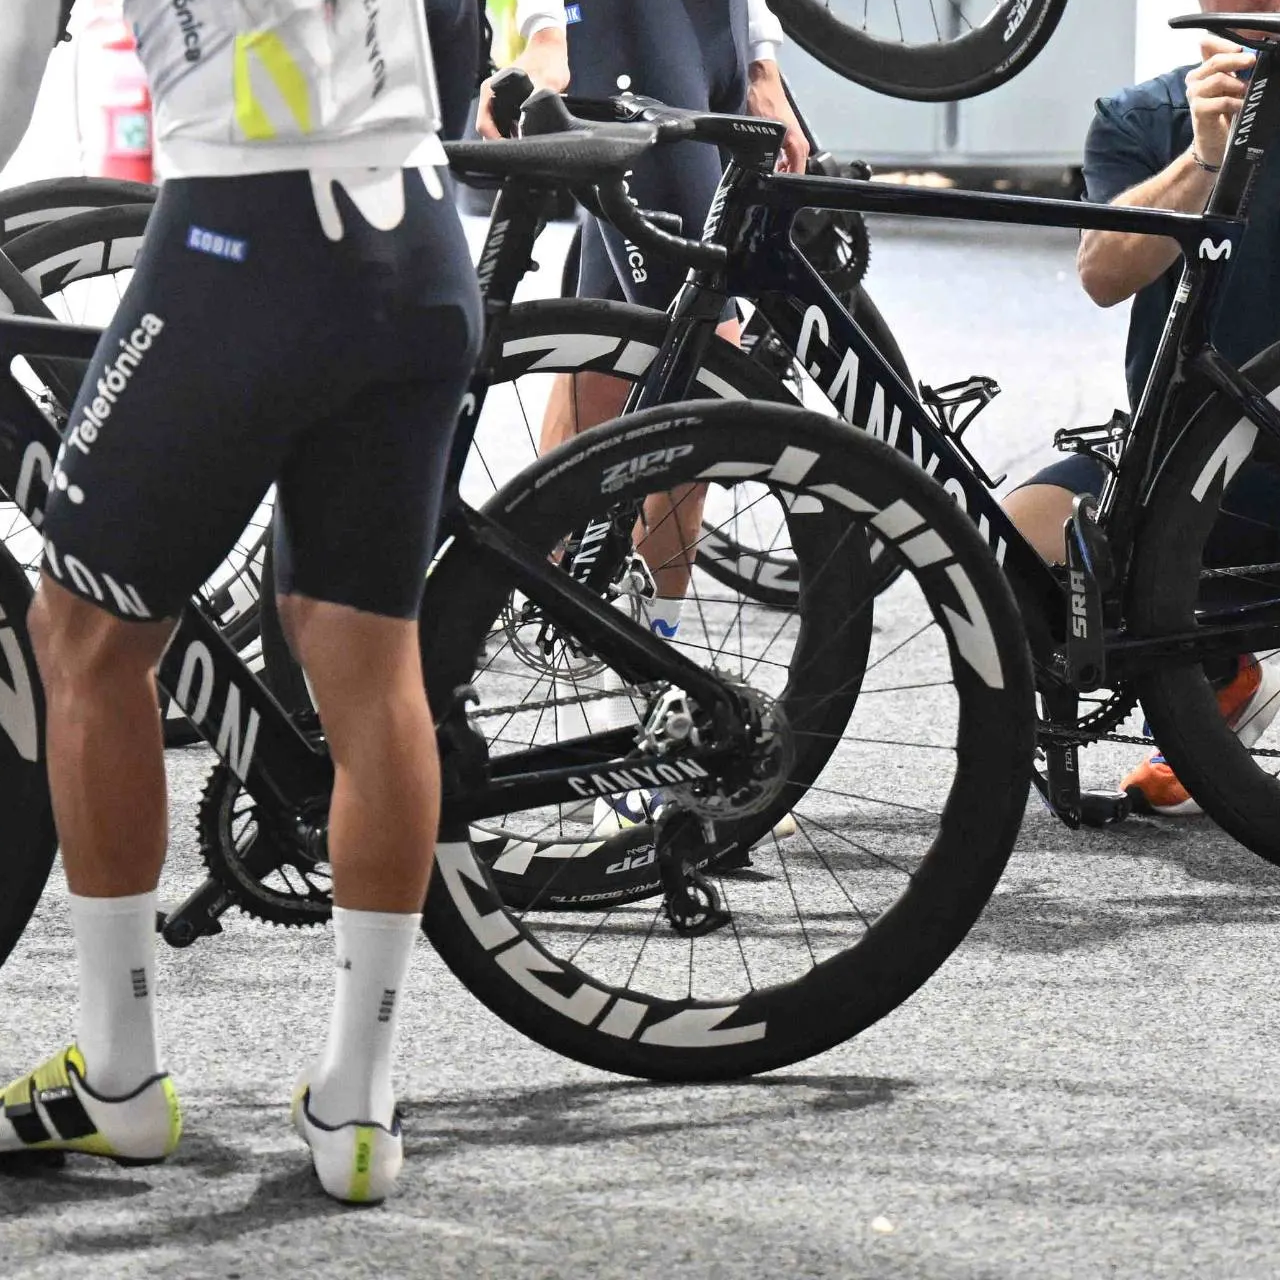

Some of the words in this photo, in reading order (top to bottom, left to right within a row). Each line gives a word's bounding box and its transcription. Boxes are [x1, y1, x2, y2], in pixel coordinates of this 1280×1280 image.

[732, 122, 778, 137] CANYON
[1234, 78, 1269, 145] CANYON
[189, 226, 245, 261] GOBIK
[68, 314, 164, 455] Telefónica
[602, 444, 695, 482] ZIPP
[568, 758, 709, 797] CANYON
[580, 890, 624, 902] 5000
